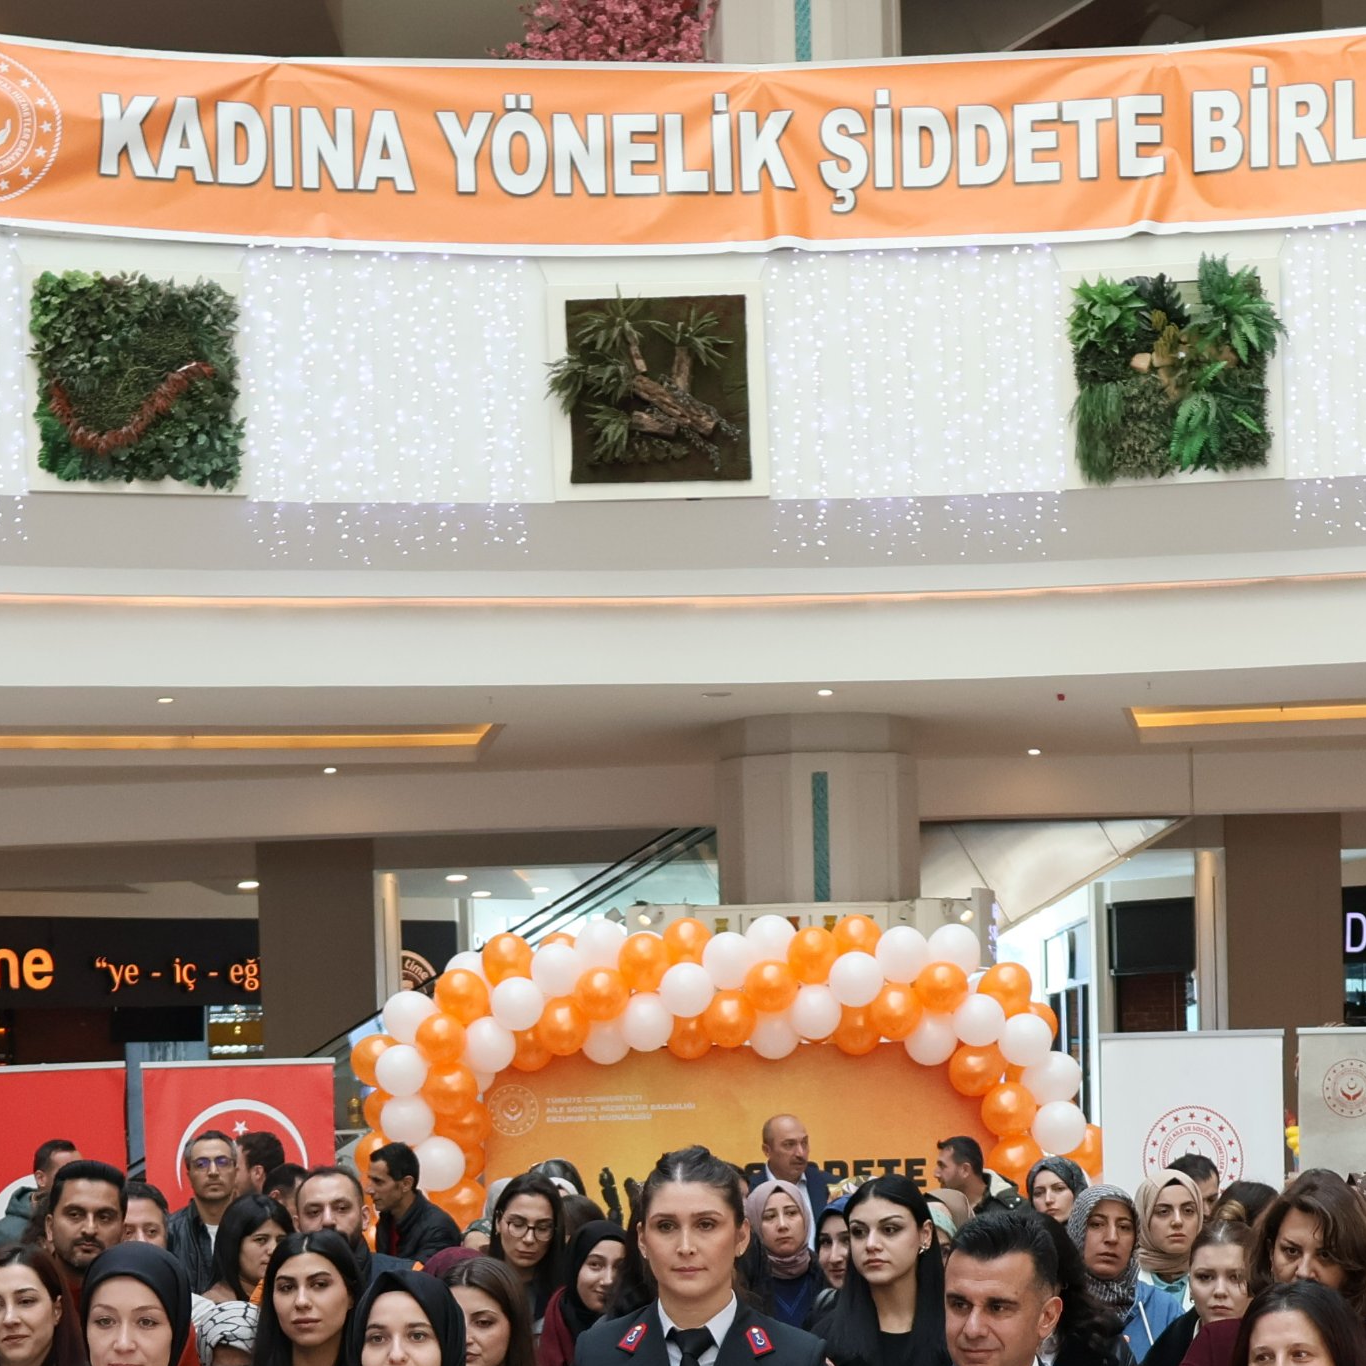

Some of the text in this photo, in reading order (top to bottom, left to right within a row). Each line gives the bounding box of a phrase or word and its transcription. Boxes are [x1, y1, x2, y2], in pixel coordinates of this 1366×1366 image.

[99, 92, 416, 193] KADINA
[436, 93, 795, 196] YÖNELİK
[818, 89, 1165, 213] ŞİDDETE
[229, 958, 260, 991] eğ
